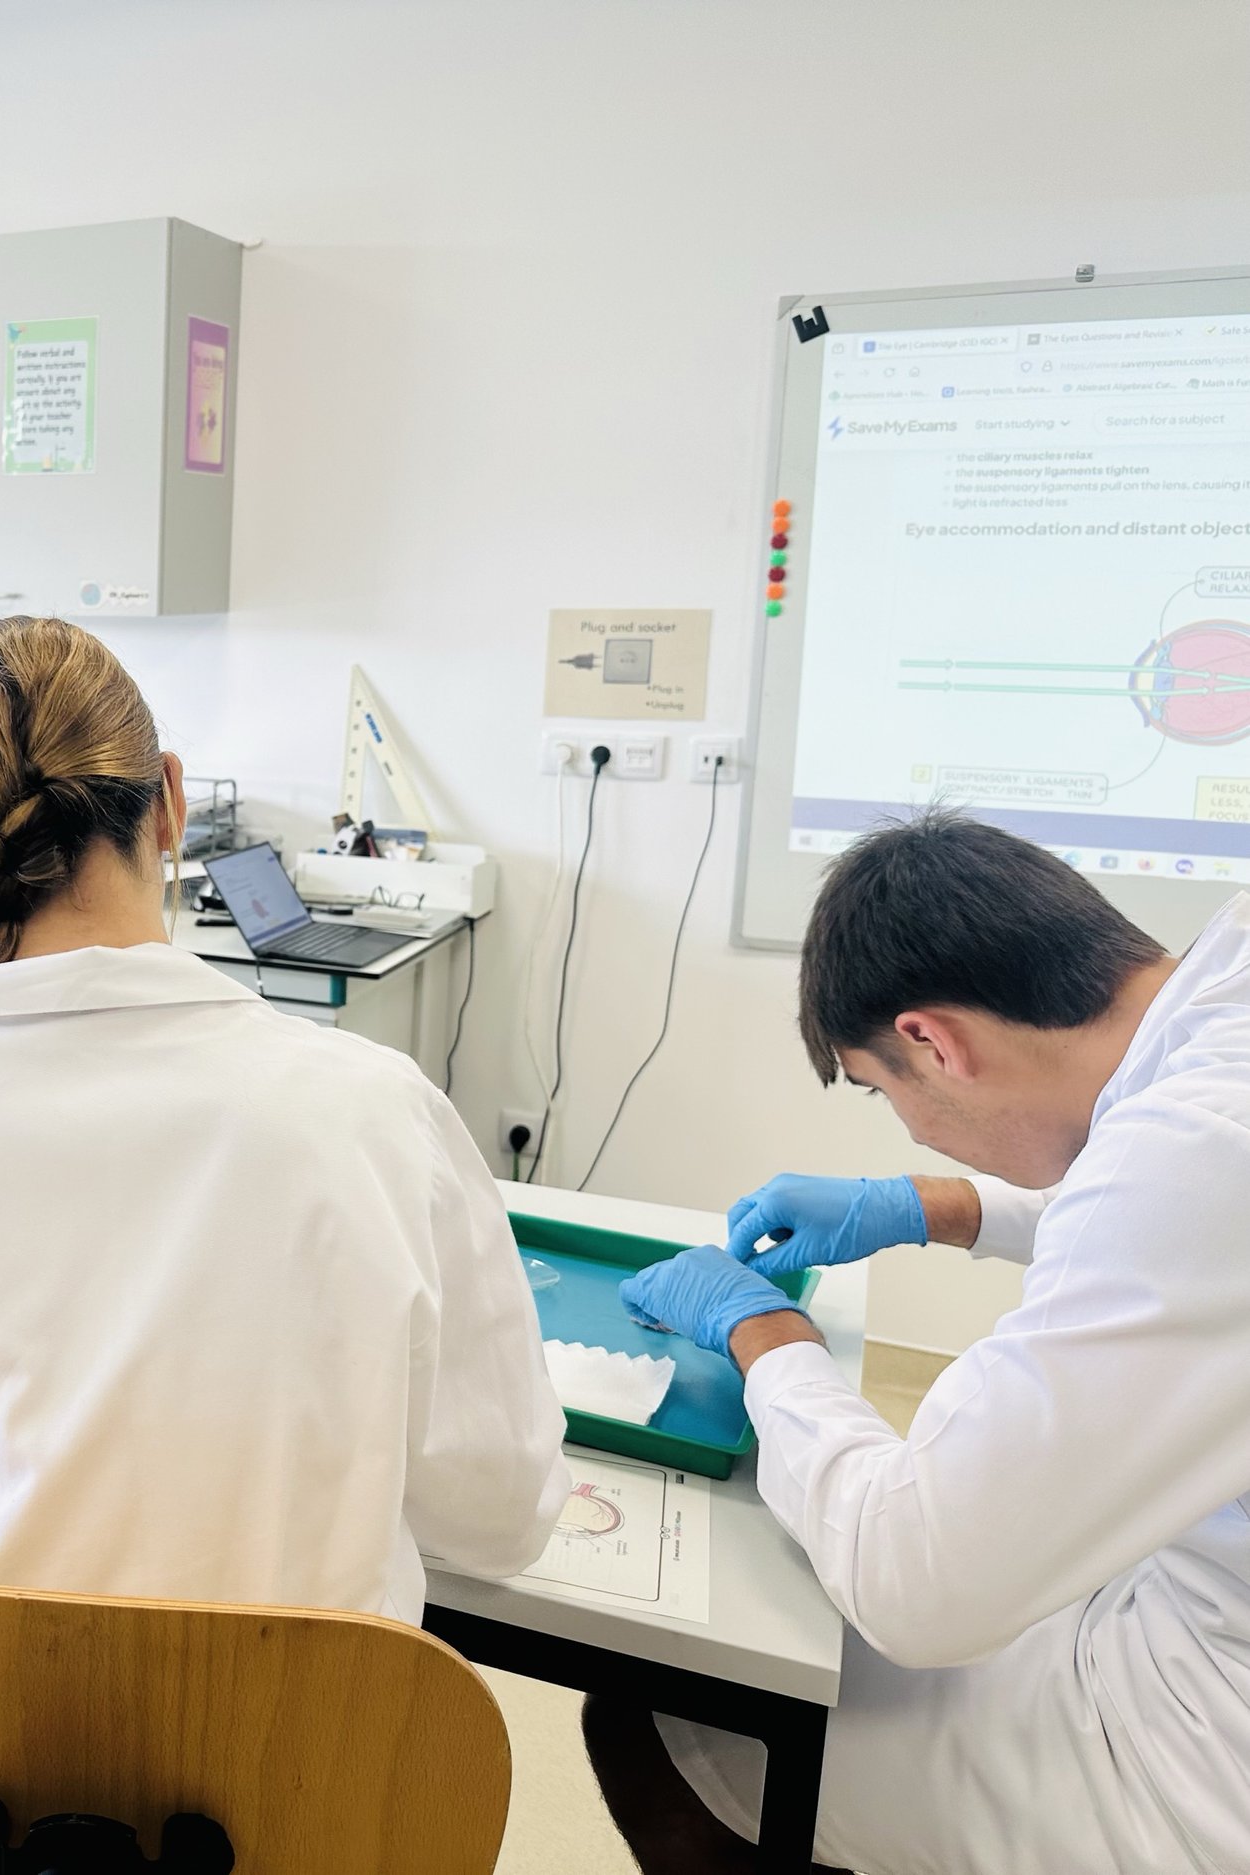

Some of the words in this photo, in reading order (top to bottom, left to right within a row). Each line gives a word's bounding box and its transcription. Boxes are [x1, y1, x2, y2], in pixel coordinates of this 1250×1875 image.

[1061, 333, 1079, 343] Eyes
[1081, 332, 1122, 341] Questions
[1124, 331, 1140, 339] and
[914, 340, 958, 349] Cambridge
[1076, 383, 1110, 392] Abstract
[1112, 382, 1153, 392] Algebraic
[1202, 379, 1225, 388] Math
[975, 419, 1002, 430] Start
[1004, 418, 1055, 431] studying
[1106, 415, 1151, 427] Search
[1151, 414, 1167, 426] for
[1168, 416, 1177, 426] a
[1178, 414, 1225, 427] subject
[957, 452, 975, 462] the
[977, 451, 1012, 463] ciliary
[1014, 451, 1062, 461] muscles
[1064, 450, 1093, 460] relax
[955, 468, 974, 477] the
[976, 467, 1043, 479] suspensory
[1044, 466, 1103, 479] ligaments
[1105, 465, 1150, 477] tighten
[954, 483, 973, 493] the
[974, 483, 1039, 494] suspensory
[1041, 481, 1098, 494] ligaments
[1100, 481, 1122, 493] pull
[1123, 482, 1140, 491] on
[1141, 480, 1161, 490] the
[1192, 479, 1240, 492] causing
[952, 498, 977, 510] light
[978, 498, 988, 507] is
[989, 497, 1043, 507] refracted
[1045, 497, 1068, 507] less
[905, 522, 936, 539] Eye
[938, 521, 1082, 536] accommodation
[1085, 521, 1120, 535] and
[1122, 521, 1187, 535] distant
[580, 622, 606, 635] Plug
[610, 622, 634, 632] and
[638, 621, 677, 633] socket
[944, 771, 1019, 785] SUSPENSORY
[1026, 776, 1094, 788] LIGAMENTS
[1067, 789, 1092, 799] THIN
